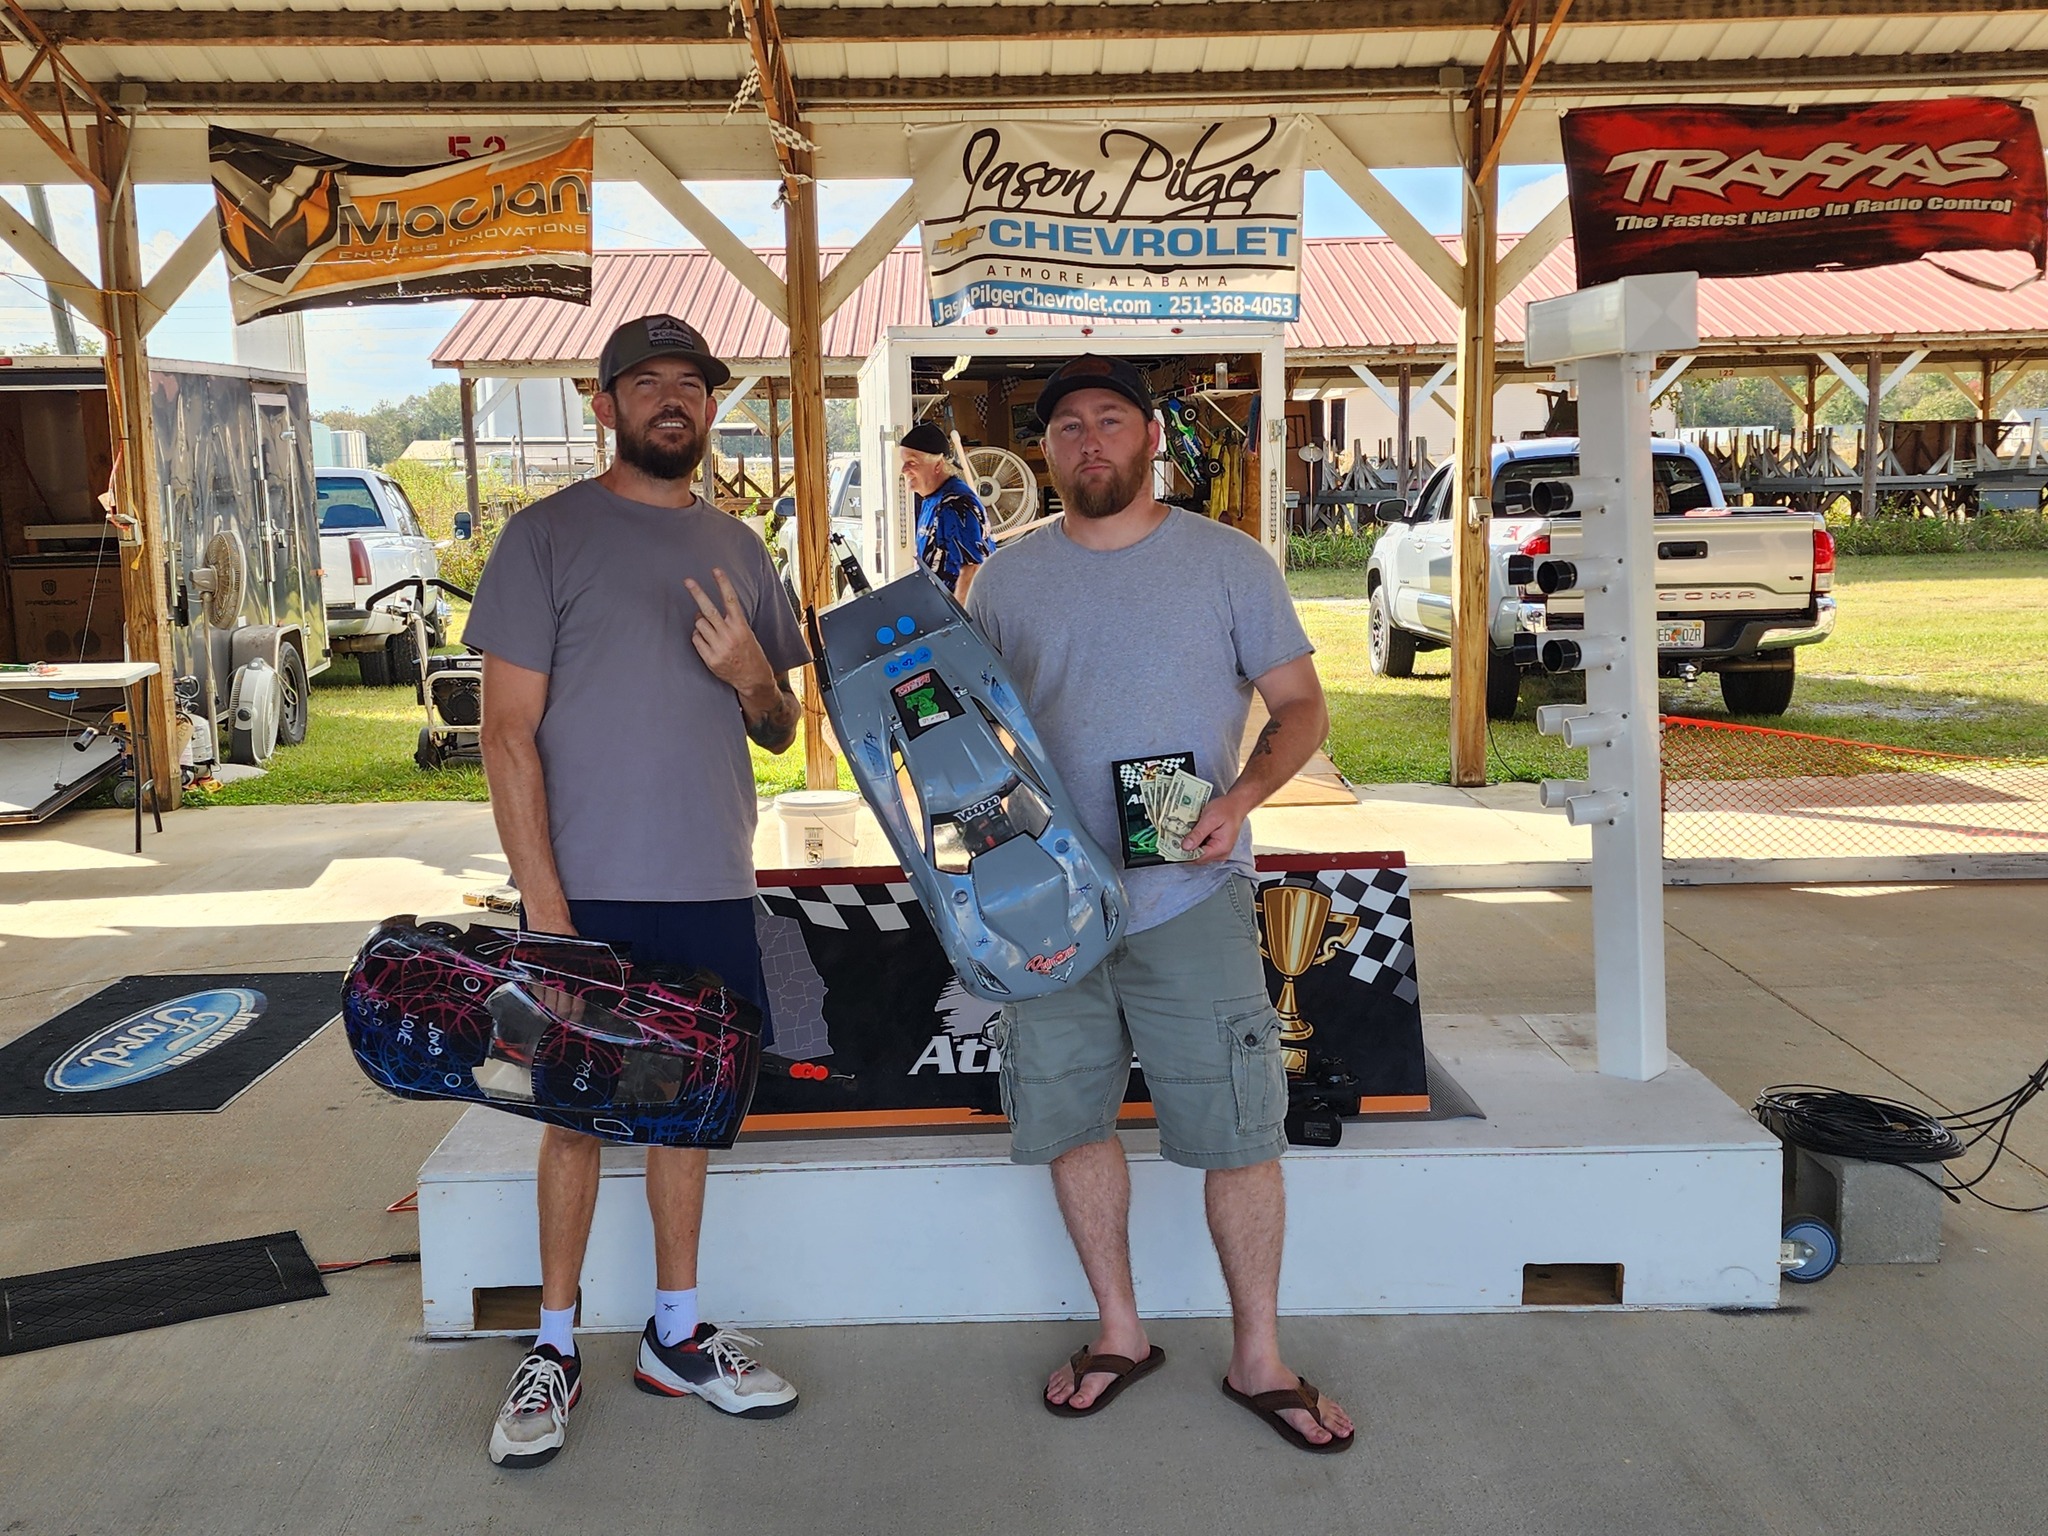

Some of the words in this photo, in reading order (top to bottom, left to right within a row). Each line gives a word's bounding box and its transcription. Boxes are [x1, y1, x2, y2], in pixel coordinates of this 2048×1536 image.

[960, 127, 1107, 223] Jason
[1100, 117, 1281, 223] Pilger
[1603, 140, 2010, 203] TRAXXAS
[338, 174, 590, 248] Maclan
[1615, 215, 1656, 231] The
[1661, 211, 1749, 229] Fastest
[1751, 207, 1820, 226] Name
[1825, 202, 1849, 217] In
[1855, 197, 1923, 215] Radio
[1927, 196, 2013, 214] Control
[449, 223, 587, 247] INNOVATIONS
[988, 218, 1297, 257] CHEVROLET
[986, 264, 1096, 287] ATMORE,
[1109, 275, 1228, 288] ALABAMA
[935, 284, 1152, 325] JasnPilgerChevrolet.com
[1169, 293, 1293, 316] 251-368-4053
[1718, 369, 1735, 378] 123
[80, 1006, 226, 1068] Ford
